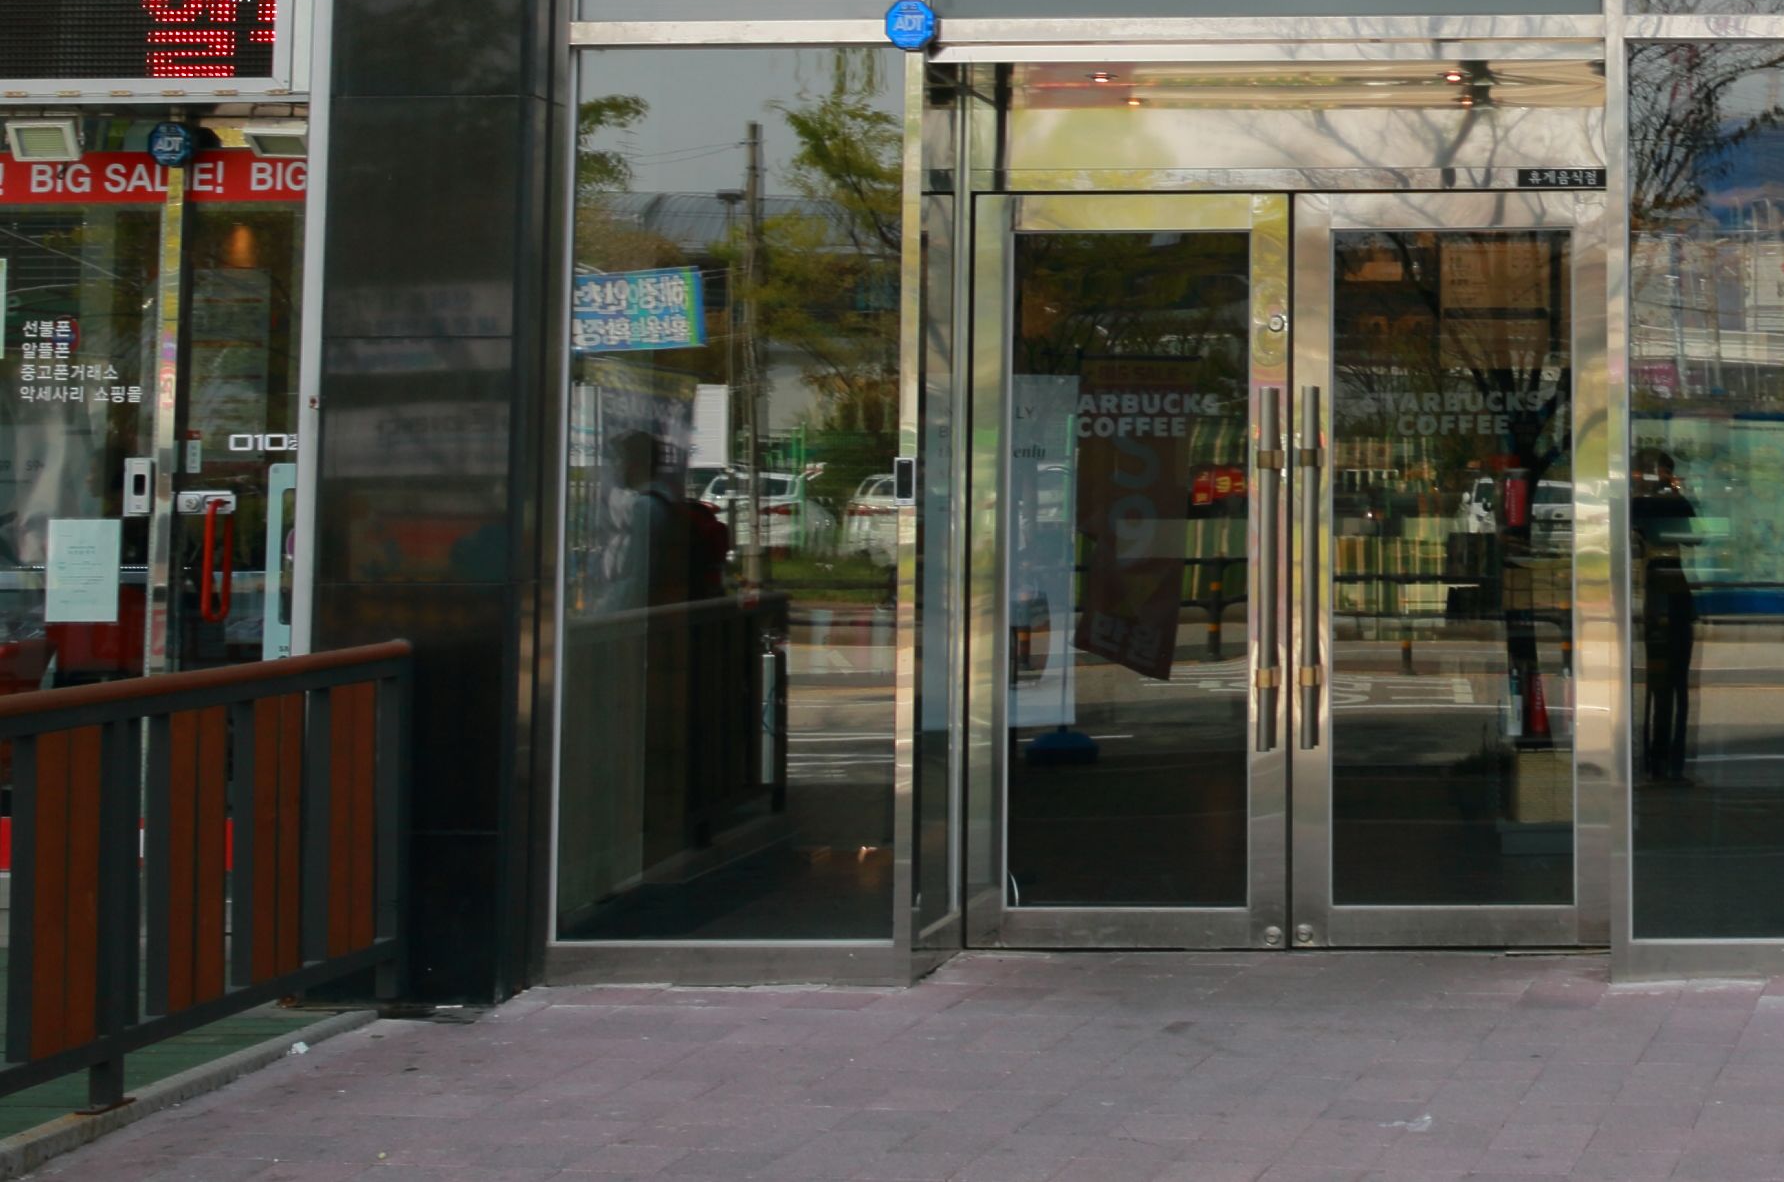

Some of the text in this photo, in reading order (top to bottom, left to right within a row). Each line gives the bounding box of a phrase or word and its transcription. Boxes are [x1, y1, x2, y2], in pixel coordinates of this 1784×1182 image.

[892, 15, 925, 31] ADT
[153, 137, 184, 152] ADT
[30, 163, 91, 193] BIG
[250, 161, 306, 191] BIG
[1528, 170, 1598, 186] 휴게음식점
[22, 320, 71, 338] 선불폰
[21, 342, 70, 359] 알뜰폰
[20, 364, 119, 381] 중고폰거래소
[20, 386, 143, 403] 악세사리 쇼핑몰
[1077, 417, 1187, 438] COFFEE
[1396, 415, 1510, 436] COFFEE
